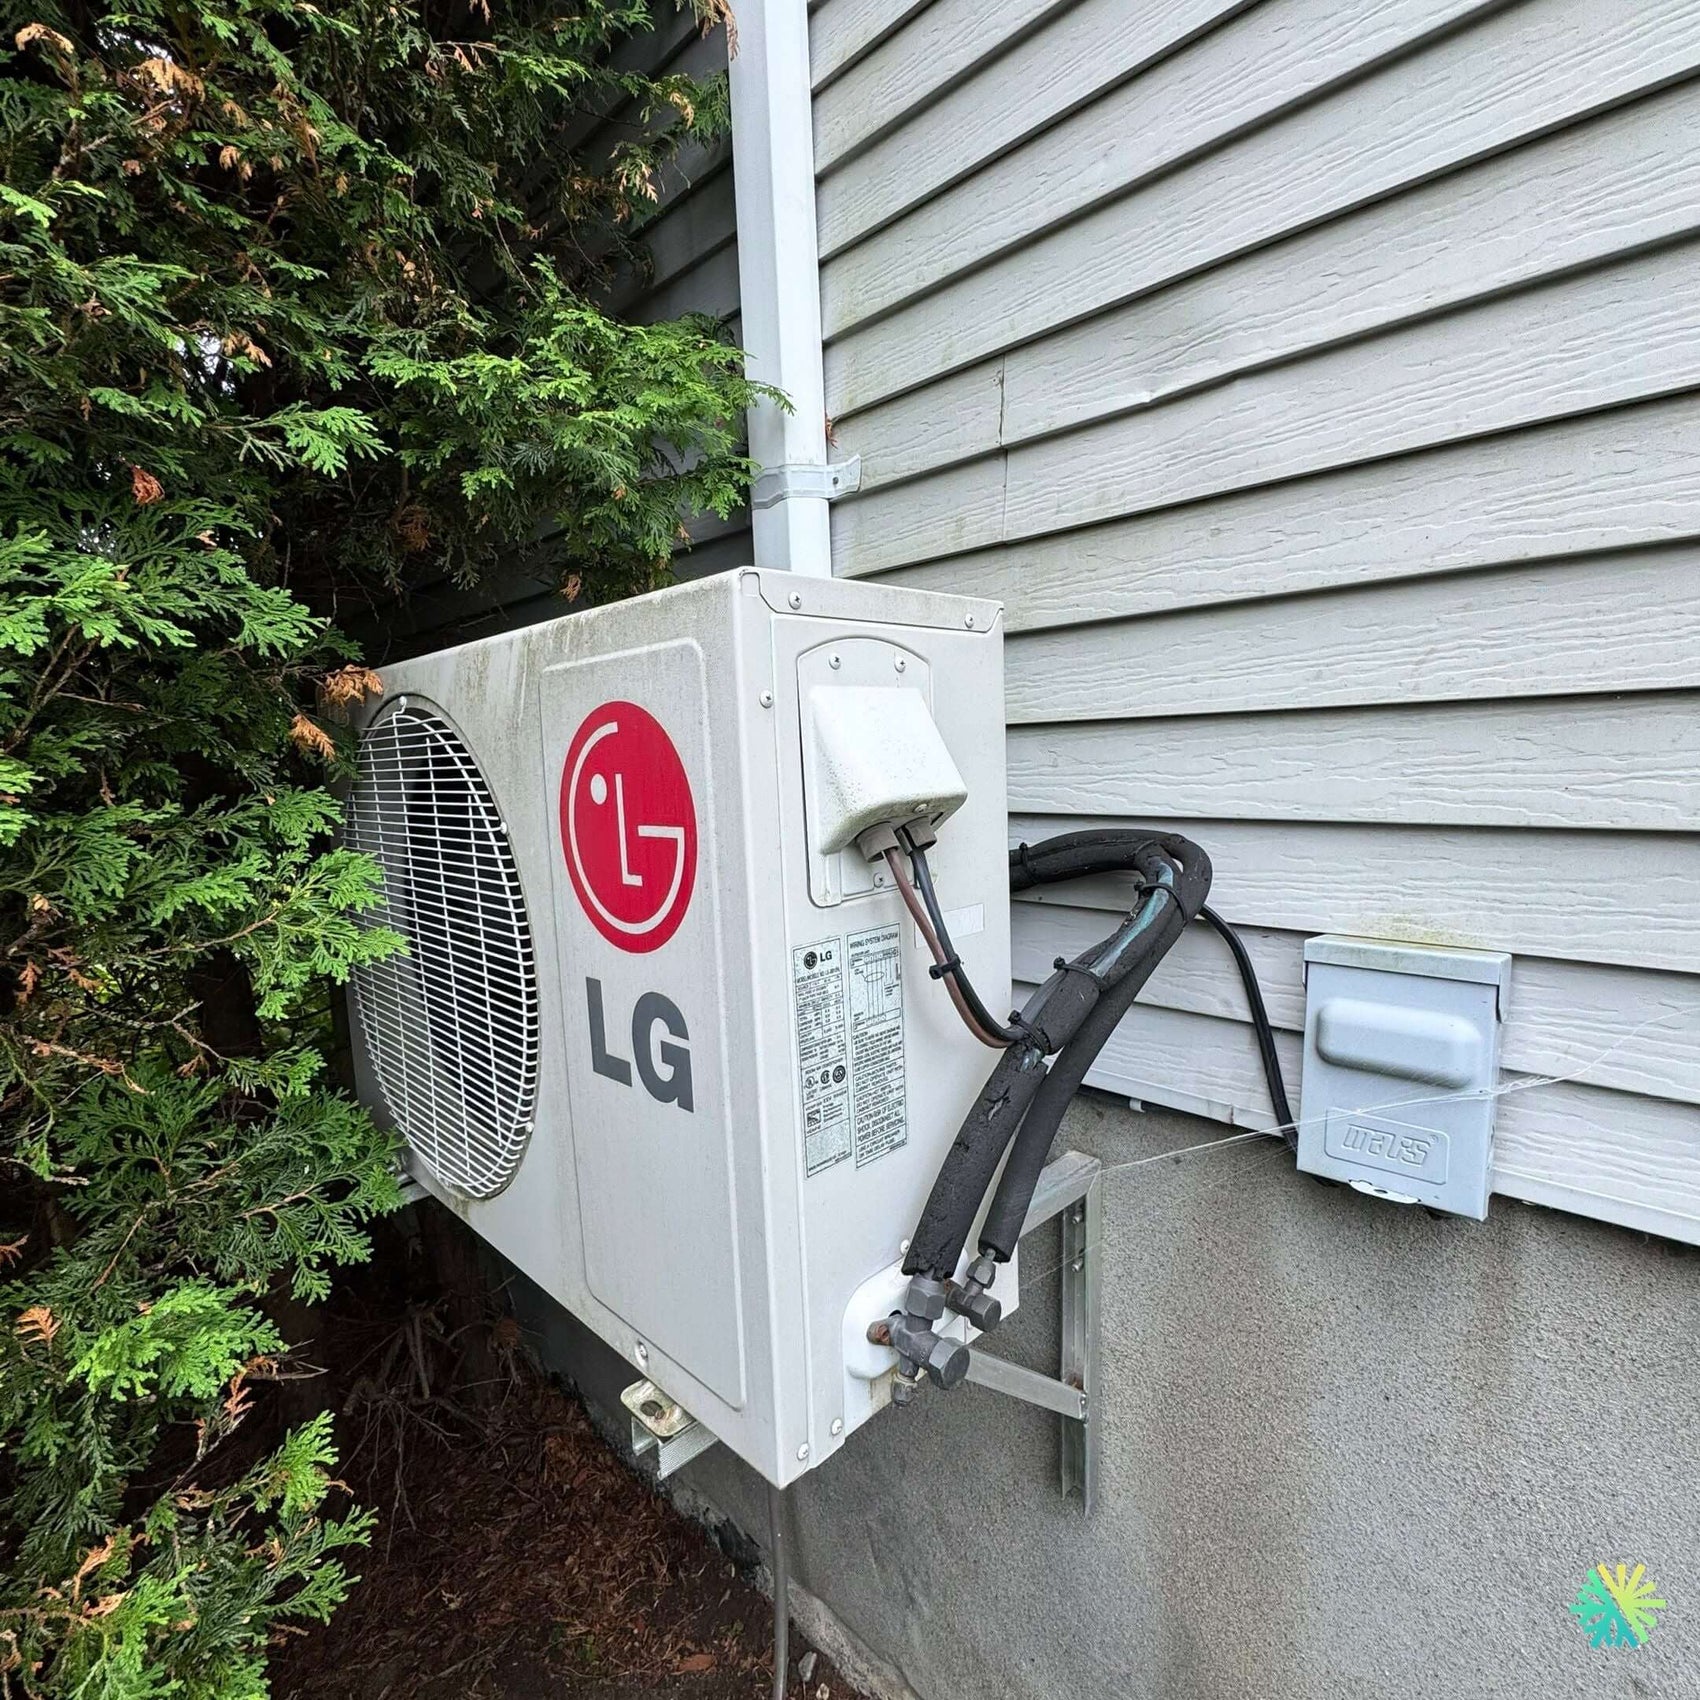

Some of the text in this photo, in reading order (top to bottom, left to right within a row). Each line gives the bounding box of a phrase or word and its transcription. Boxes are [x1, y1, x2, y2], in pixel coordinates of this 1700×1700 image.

[850, 931, 898, 949] WIRING SYSTEM DIAGRAM
[820, 950, 832, 962] LG
[585, 977, 695, 1113] LG
